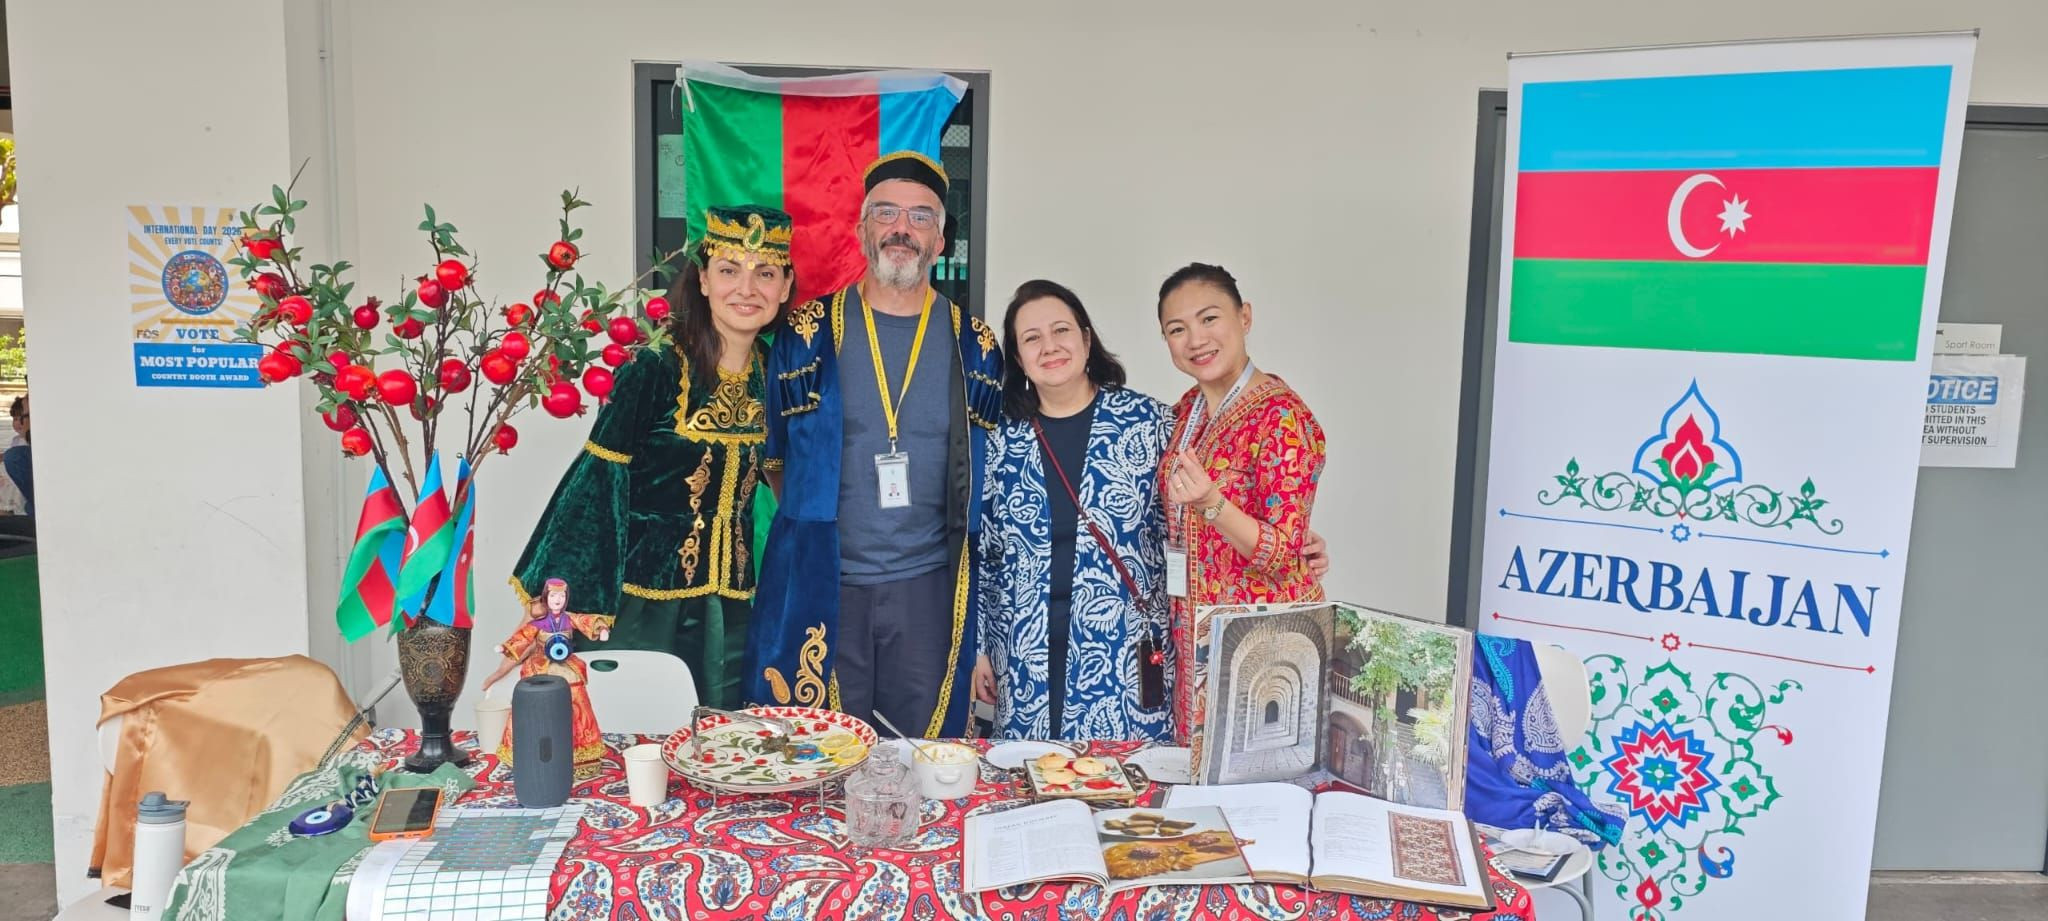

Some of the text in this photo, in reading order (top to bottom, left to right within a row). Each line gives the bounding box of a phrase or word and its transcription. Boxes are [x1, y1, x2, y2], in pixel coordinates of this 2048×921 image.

[144, 224, 198, 235] INTERNATIONAL
[203, 225, 217, 235] DAY
[165, 237, 181, 245] EVERY
[184, 237, 197, 245] VOTE
[176, 328, 220, 339] VOTE
[1945, 340, 1995, 350] Sport Room
[140, 356, 259, 369] MOST POPULAR
[219, 374, 250, 382] AWARD
[1930, 405, 1976, 414] STUDENTS
[1955, 415, 1965, 424] IN
[1967, 416, 1986, 425] THIS
[1923, 425, 1976, 435] EA WITHOUT
[1927, 435, 1987, 445] SUPERVISION
[1498, 545, 1880, 637] AZERBAIJAN
